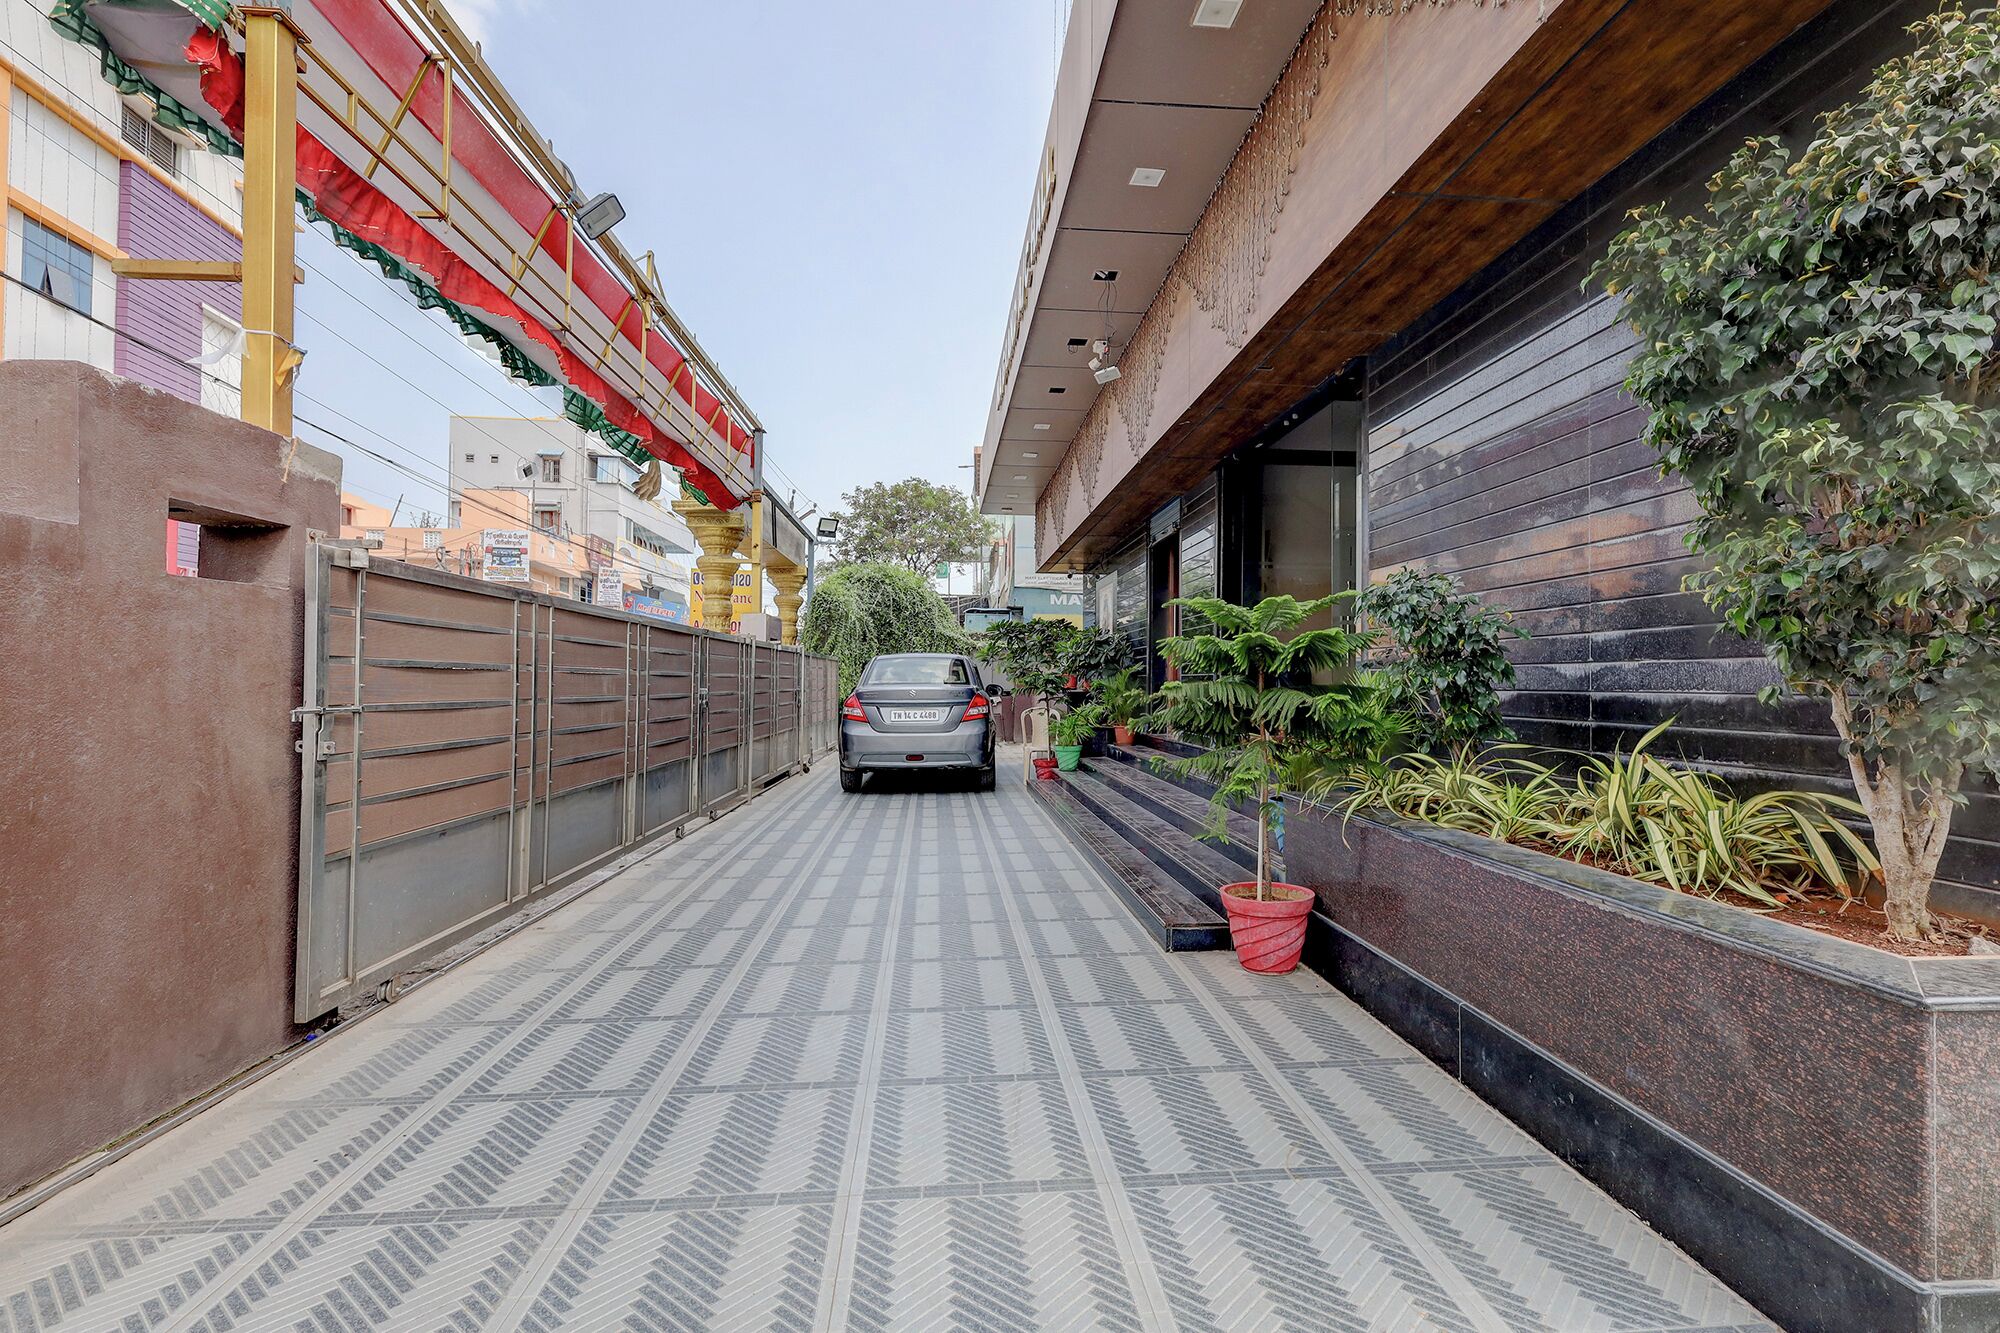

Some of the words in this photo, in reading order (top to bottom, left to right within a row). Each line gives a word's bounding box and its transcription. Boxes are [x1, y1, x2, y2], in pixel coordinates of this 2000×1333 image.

[893, 711, 902, 720] TN
[904, 711, 912, 720] 14
[913, 711, 918, 720] C
